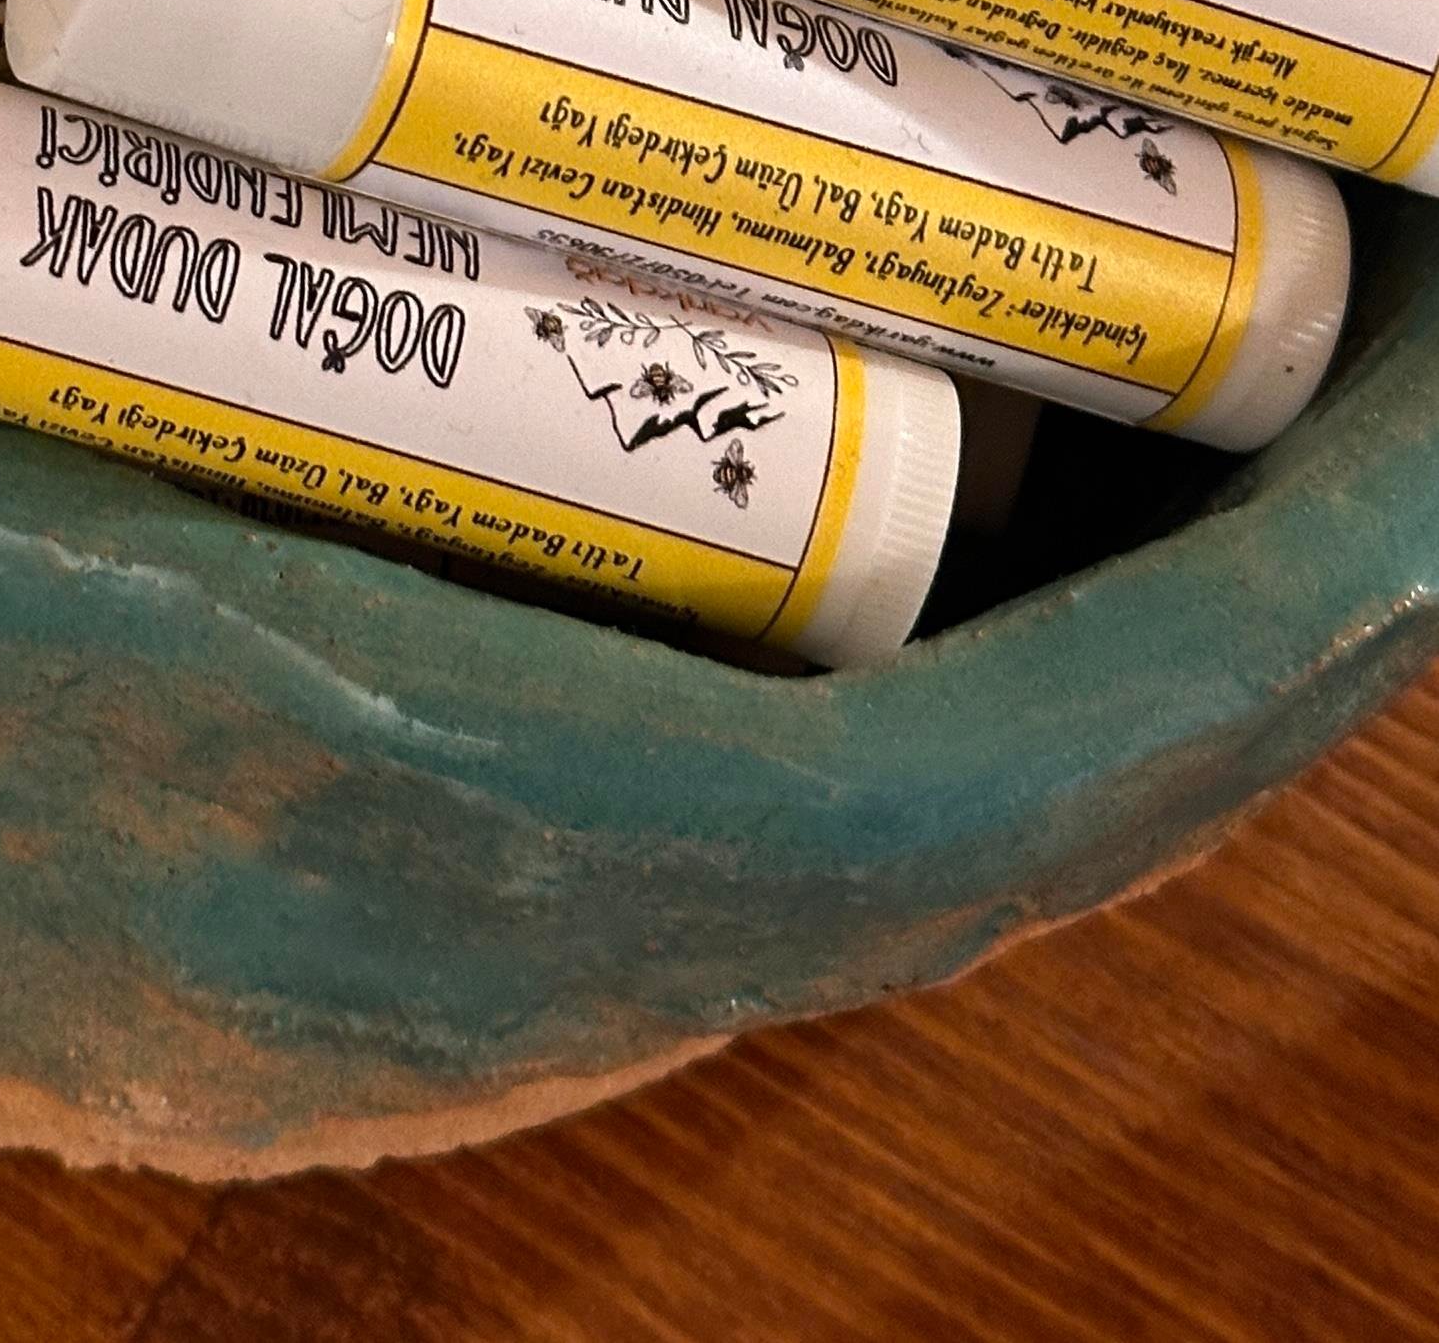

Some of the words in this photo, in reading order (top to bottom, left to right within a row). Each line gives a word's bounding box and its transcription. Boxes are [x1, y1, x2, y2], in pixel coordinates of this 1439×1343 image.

[539, 96, 597, 148] Yağı
[604, 113, 727, 184] Çekirdeği
[519, 156, 595, 200] Cevizi
[813, 175, 861, 224] Bal,
[601, 178, 722, 237] Hindistan
[871, 191, 929, 244] Yağı,
[20, 186, 240, 324] DUDAK
[732, 212, 855, 275] Balmumu,
[939, 216, 1026, 271] Badem
[1031, 243, 1097, 293] Tatlı
[263, 252, 465, 389] DOĞAL
[472, 512, 566, 559] Badem
